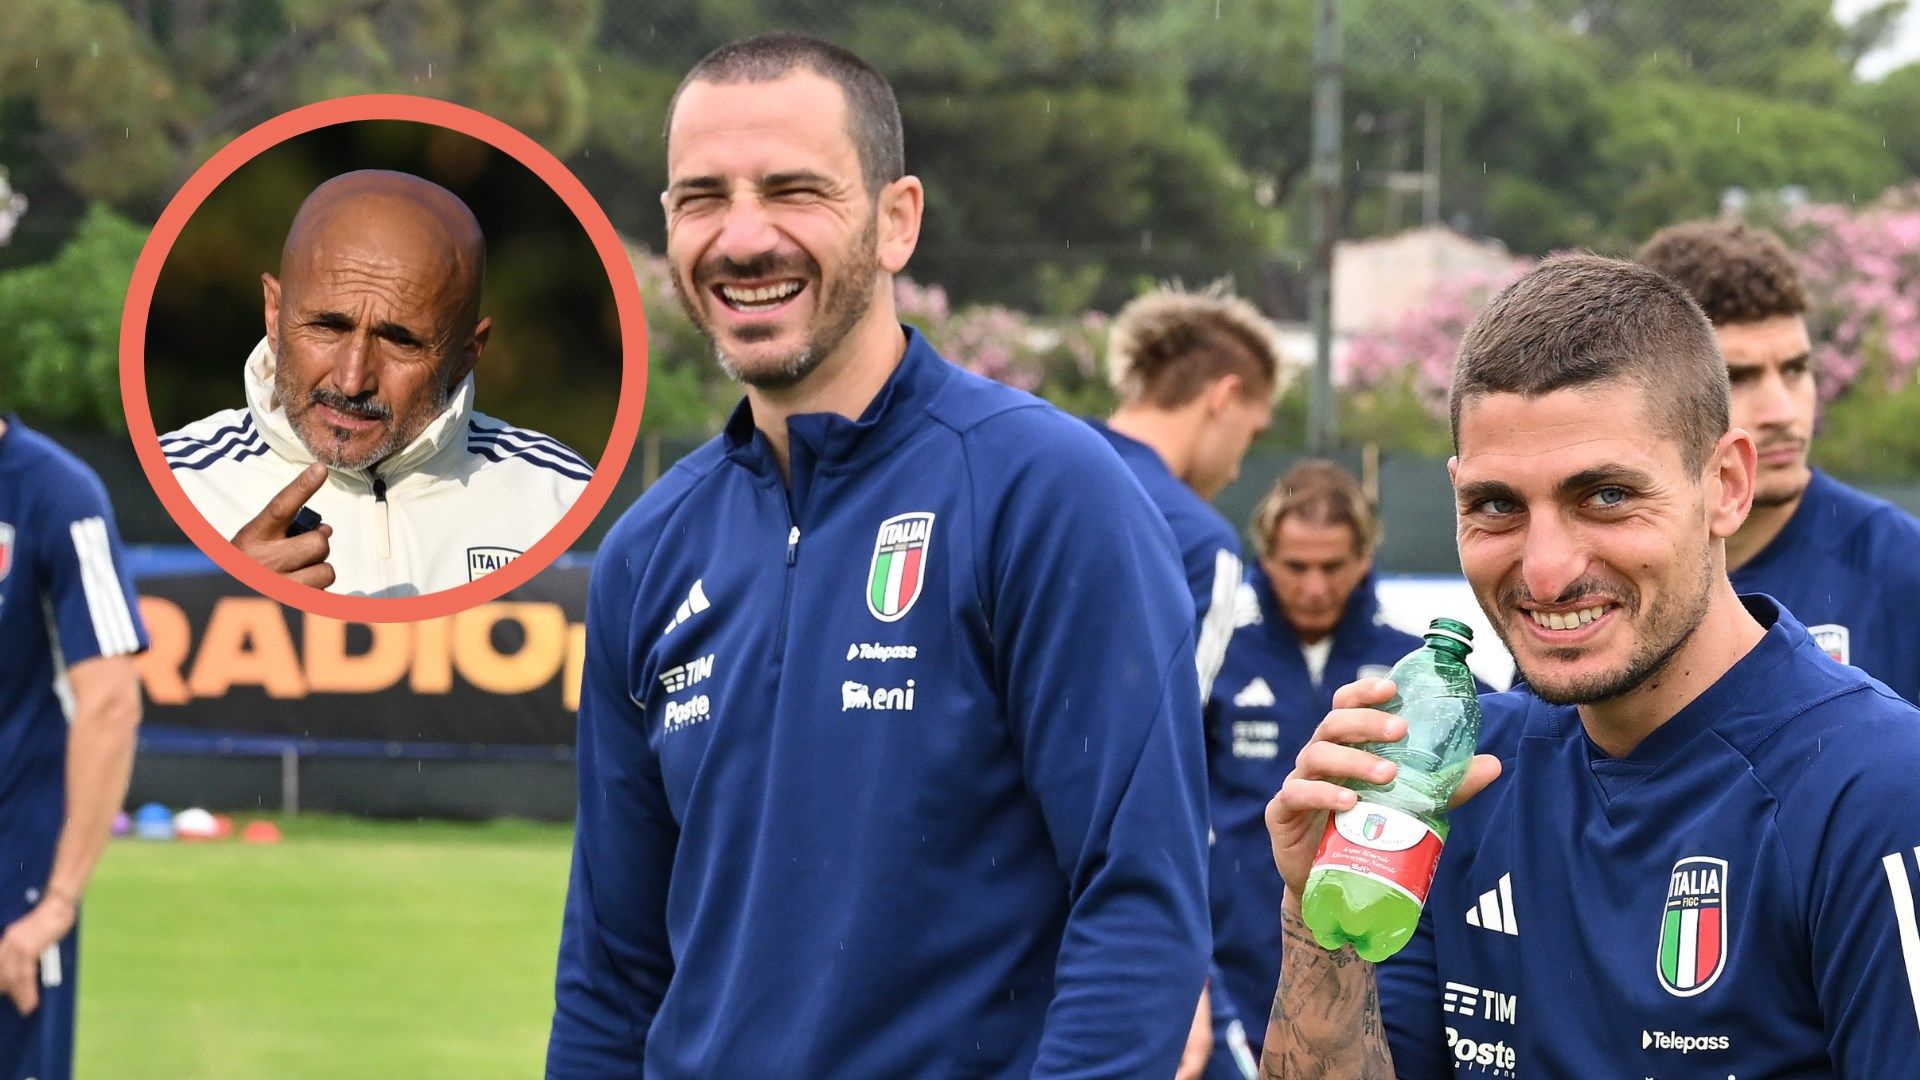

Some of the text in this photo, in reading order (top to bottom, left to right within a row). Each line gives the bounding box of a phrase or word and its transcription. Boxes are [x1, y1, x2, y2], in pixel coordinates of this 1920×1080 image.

[880, 520, 926, 546] ITALIA
[135, 595, 586, 712] RADIO
[859, 642, 918, 662] Telepass
[686, 653, 715, 687] TIM
[873, 679, 915, 710] eni
[664, 695, 710, 728] Poste
[1669, 868, 1720, 897] ITALIA
[1682, 896, 1699, 908] FIGC
[1482, 989, 1517, 1025] TIM
[1652, 1031, 1730, 1054] Telepass
